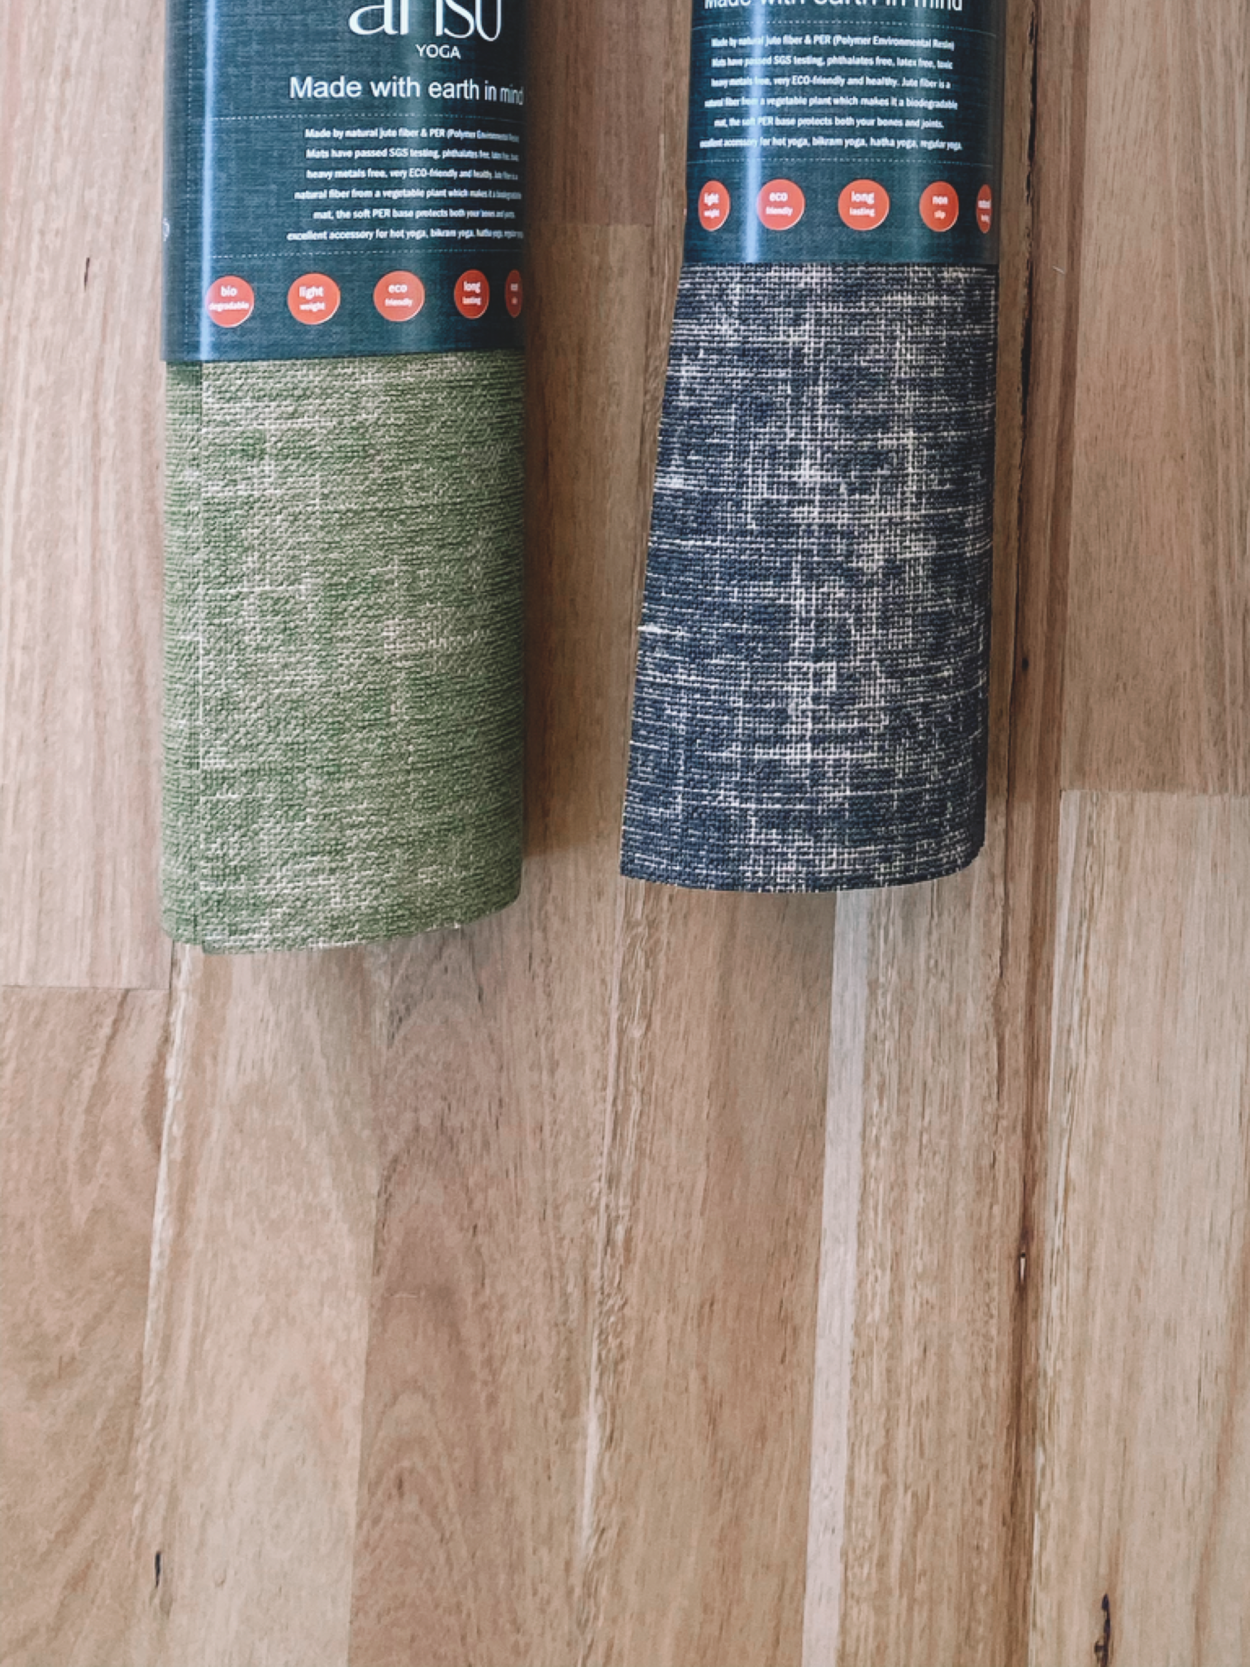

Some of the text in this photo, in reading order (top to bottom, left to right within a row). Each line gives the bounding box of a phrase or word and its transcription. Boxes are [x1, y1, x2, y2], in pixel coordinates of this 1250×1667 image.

[832, 34, 871, 47] (Polymer
[415, 44, 461, 60] YOGA
[773, 55, 792, 65] SGS
[826, 55, 875, 67] phthalates
[773, 77, 790, 88] very
[792, 75, 846, 88] ECO-friendly
[846, 76, 864, 86] and
[289, 76, 524, 106] Made with earth in mind
[834, 116, 855, 126] both
[856, 118, 876, 128] your
[877, 116, 903, 127] bones
[304, 128, 331, 138] Made
[333, 128, 344, 140] by
[345, 128, 378, 138] natural
[398, 127, 419, 138] fiber
[305, 148, 329, 159] Mats
[330, 148, 353, 158] have
[354, 148, 387, 159] passed
[388, 147, 408, 158] SGS
[769, 192, 788, 202] eco
[851, 191, 875, 204] long
[932, 195, 948, 205] non
[765, 206, 793, 216] friendly
[849, 207, 875, 217] lasting
[220, 285, 238, 297] bio
[299, 285, 324, 300] light
[388, 284, 408, 293] eco
[463, 280, 481, 294] long
[208, 301, 249, 312] degradable
[299, 302, 325, 312] weight
[384, 298, 413, 308] friendly
